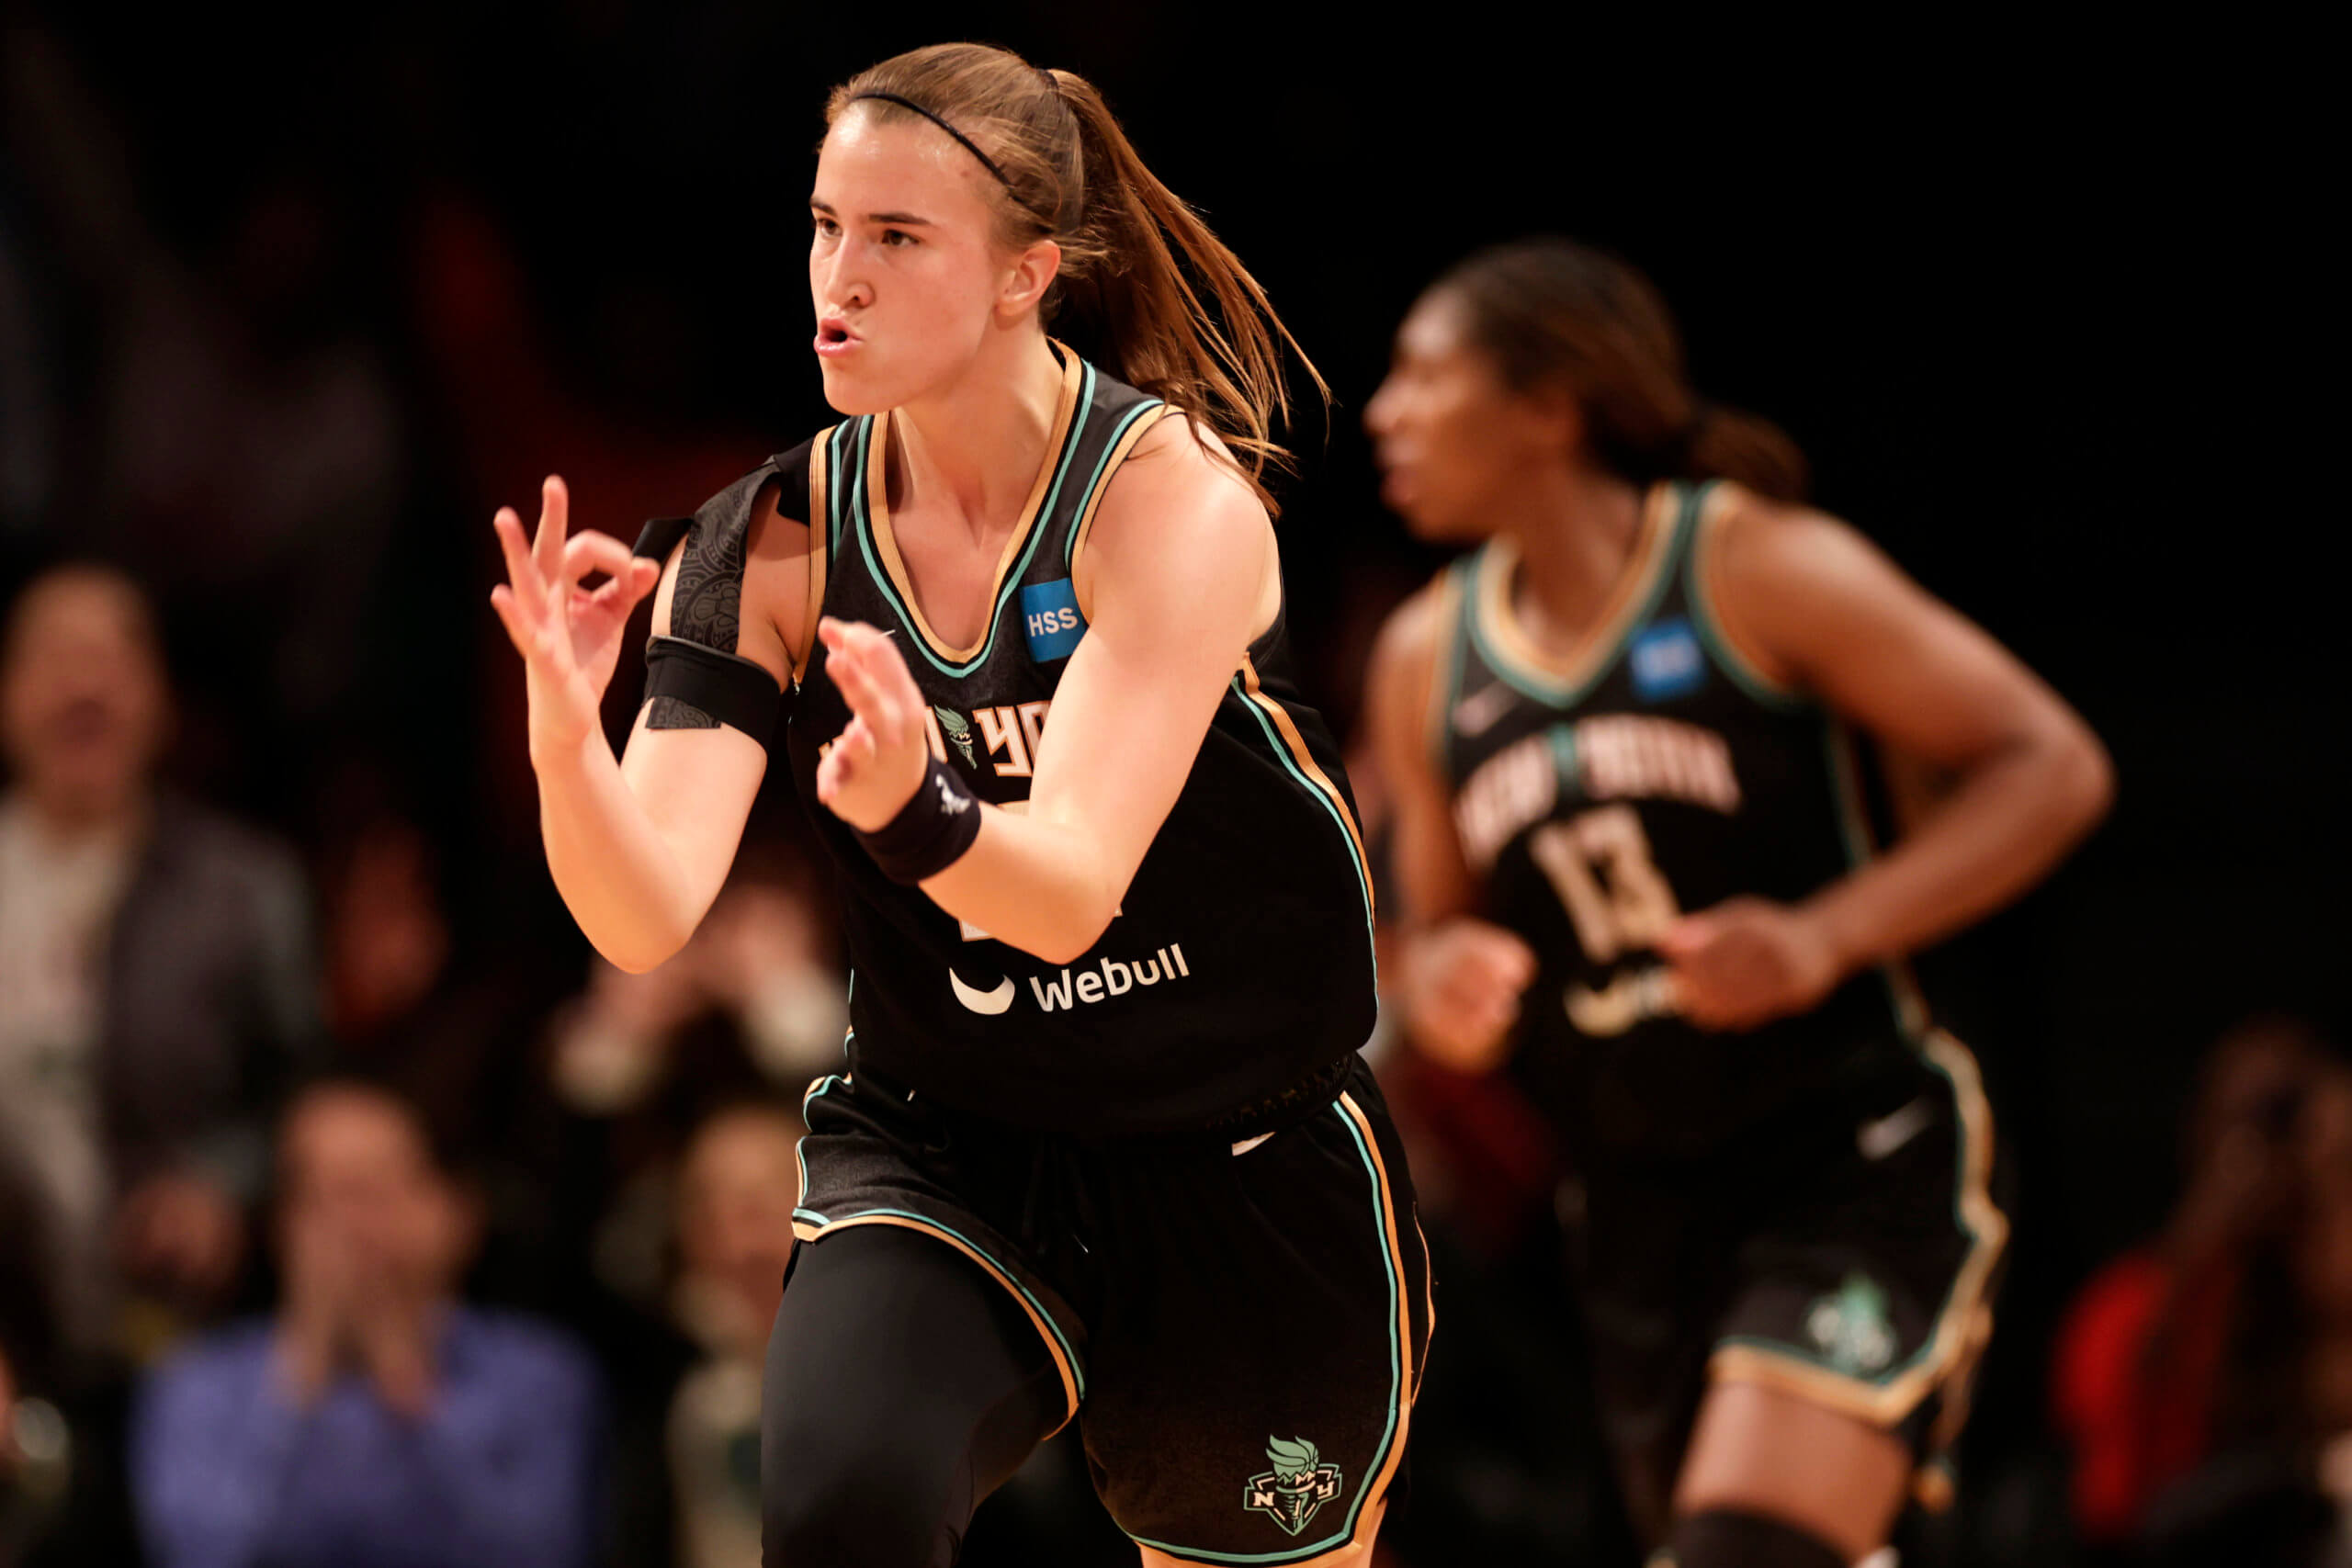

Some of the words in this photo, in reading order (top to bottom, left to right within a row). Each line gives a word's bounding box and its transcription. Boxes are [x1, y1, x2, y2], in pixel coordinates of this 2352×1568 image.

[1027, 606, 1079, 638] HSS
[971, 699, 1053, 778] YO
[1526, 802, 1685, 965] 13
[1028, 942, 1192, 1013] Webull
[1252, 1491, 1275, 1507] N
[1316, 1480, 1336, 1501] Y
